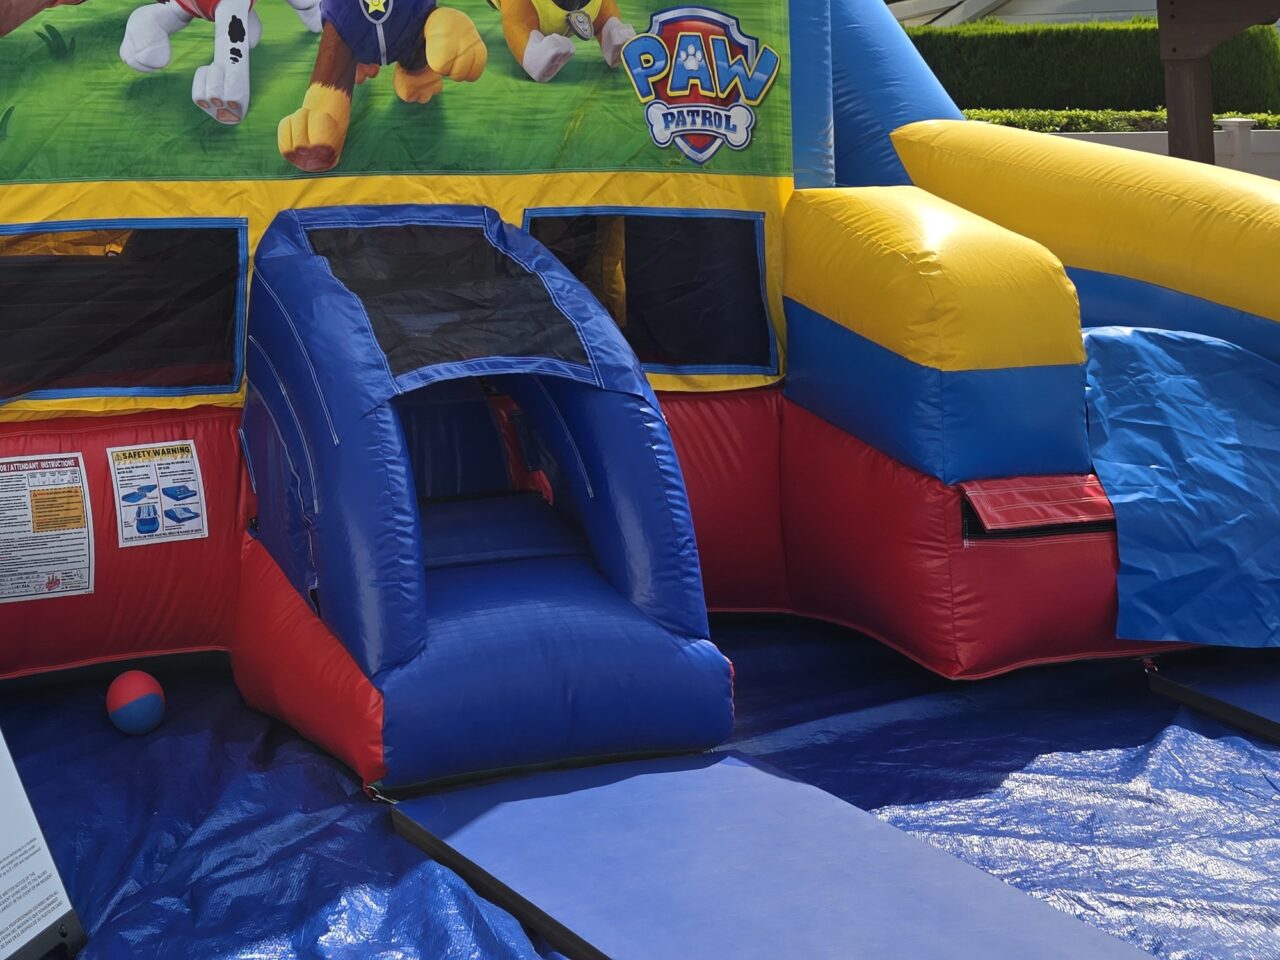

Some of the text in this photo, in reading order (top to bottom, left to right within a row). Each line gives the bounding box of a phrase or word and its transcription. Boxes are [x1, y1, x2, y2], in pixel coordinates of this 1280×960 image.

[621, 32, 781, 106] PAW
[662, 109, 737, 133] PATROL
[123, 446, 190, 459] SAFETY WARNING
[40, 459, 75, 469] INSTRUCTIONS
